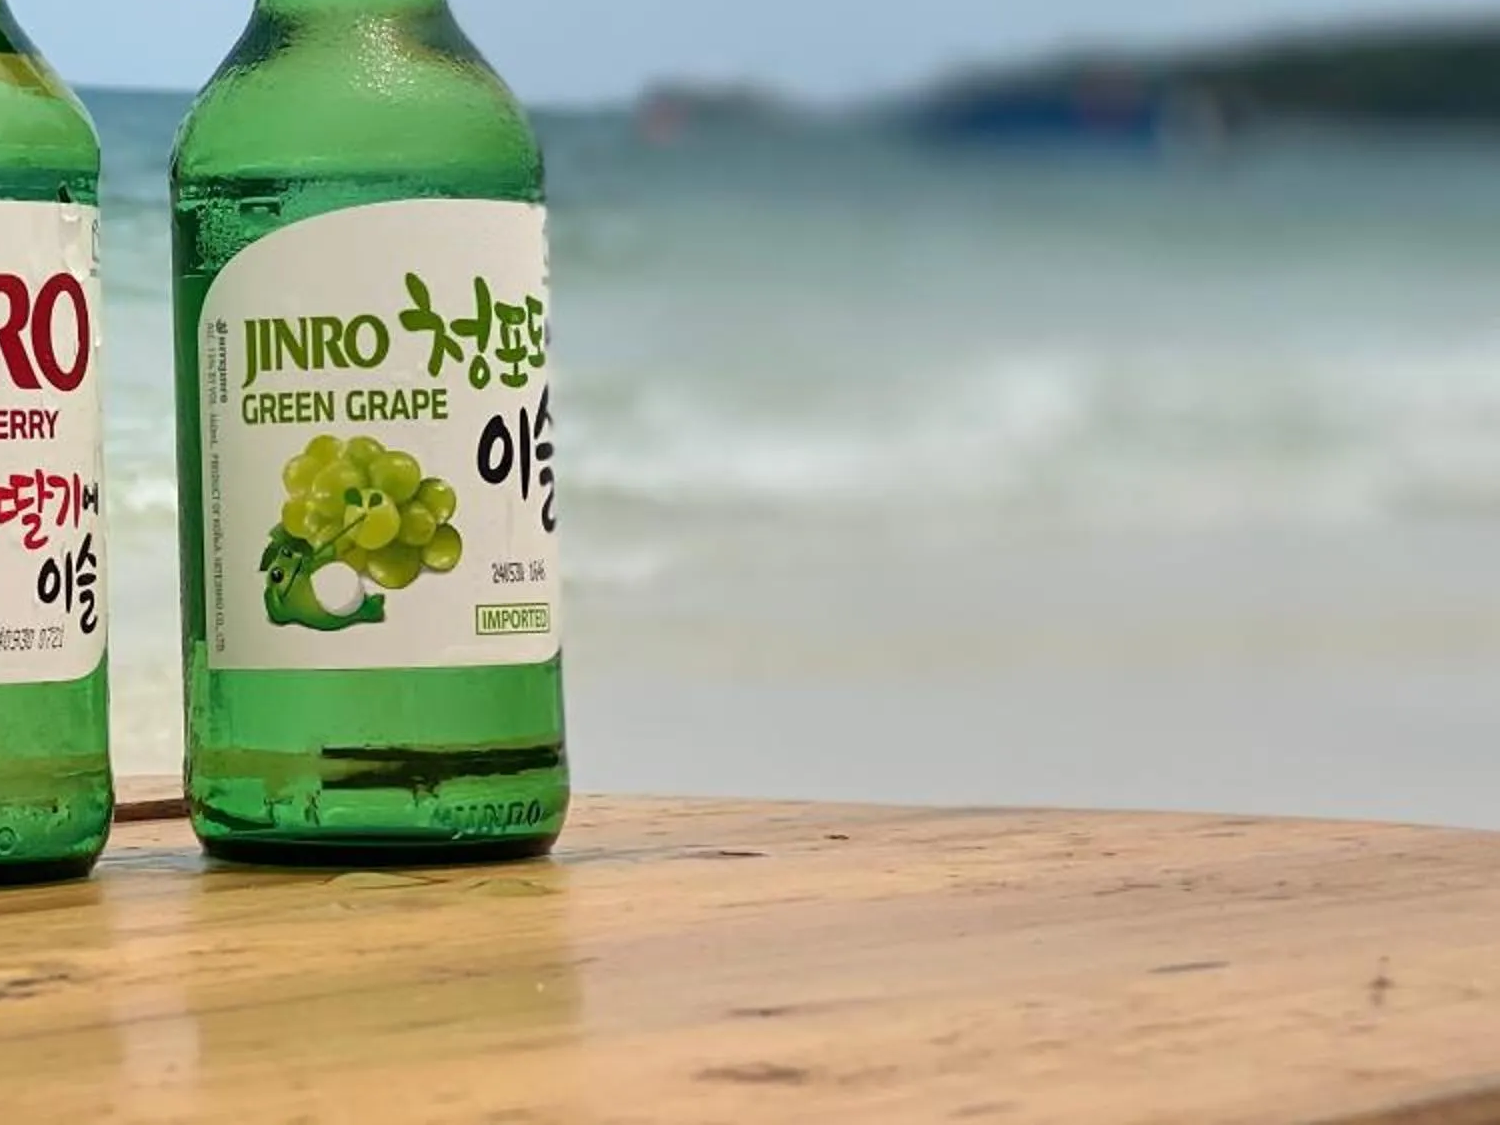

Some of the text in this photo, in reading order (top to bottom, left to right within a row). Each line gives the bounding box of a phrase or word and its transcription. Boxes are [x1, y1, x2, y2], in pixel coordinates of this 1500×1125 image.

[242, 314, 390, 389] JINRO
[242, 388, 449, 425] GREEN GRAPE
[37, 533, 98, 635] 이슬
[482, 608, 547, 630] IMPORTED
